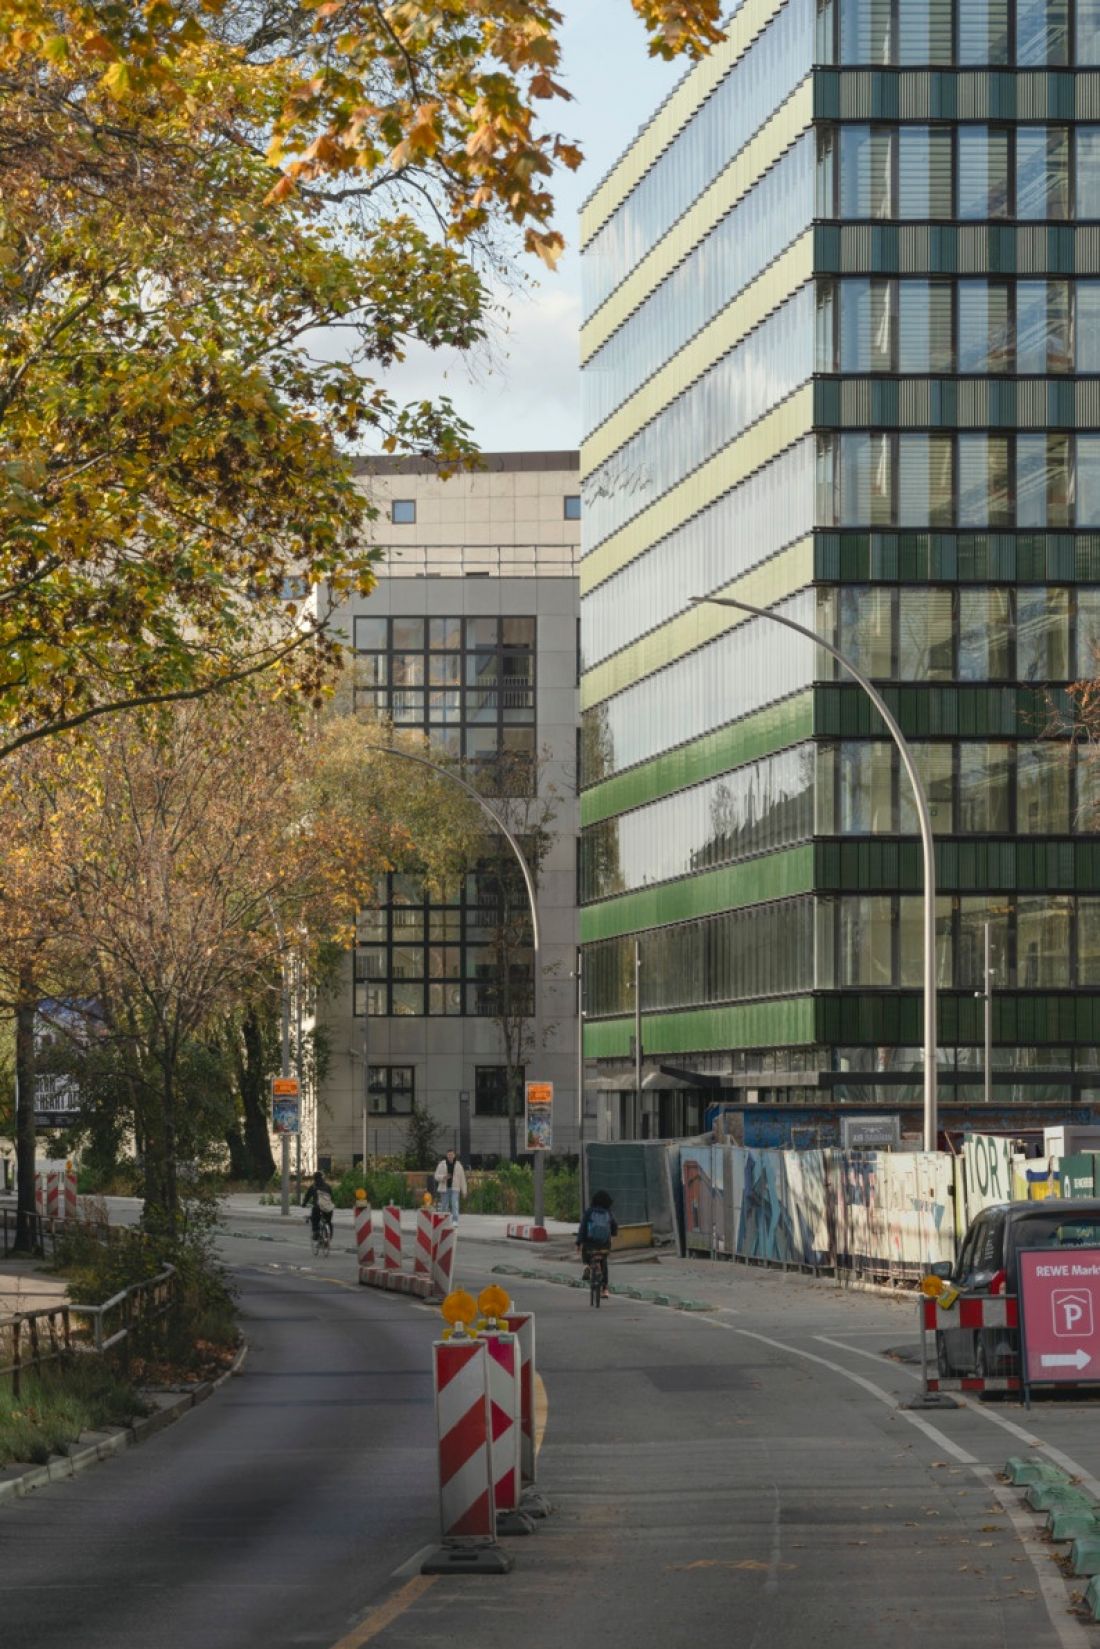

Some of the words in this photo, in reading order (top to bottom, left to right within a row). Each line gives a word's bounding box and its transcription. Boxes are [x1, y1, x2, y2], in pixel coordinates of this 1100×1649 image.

[963, 1134, 1003, 1200] TOR
[1035, 1265, 1070, 1277] REWE
[1071, 1264, 1100, 1276] Mark
[1063, 1304, 1083, 1330] P
